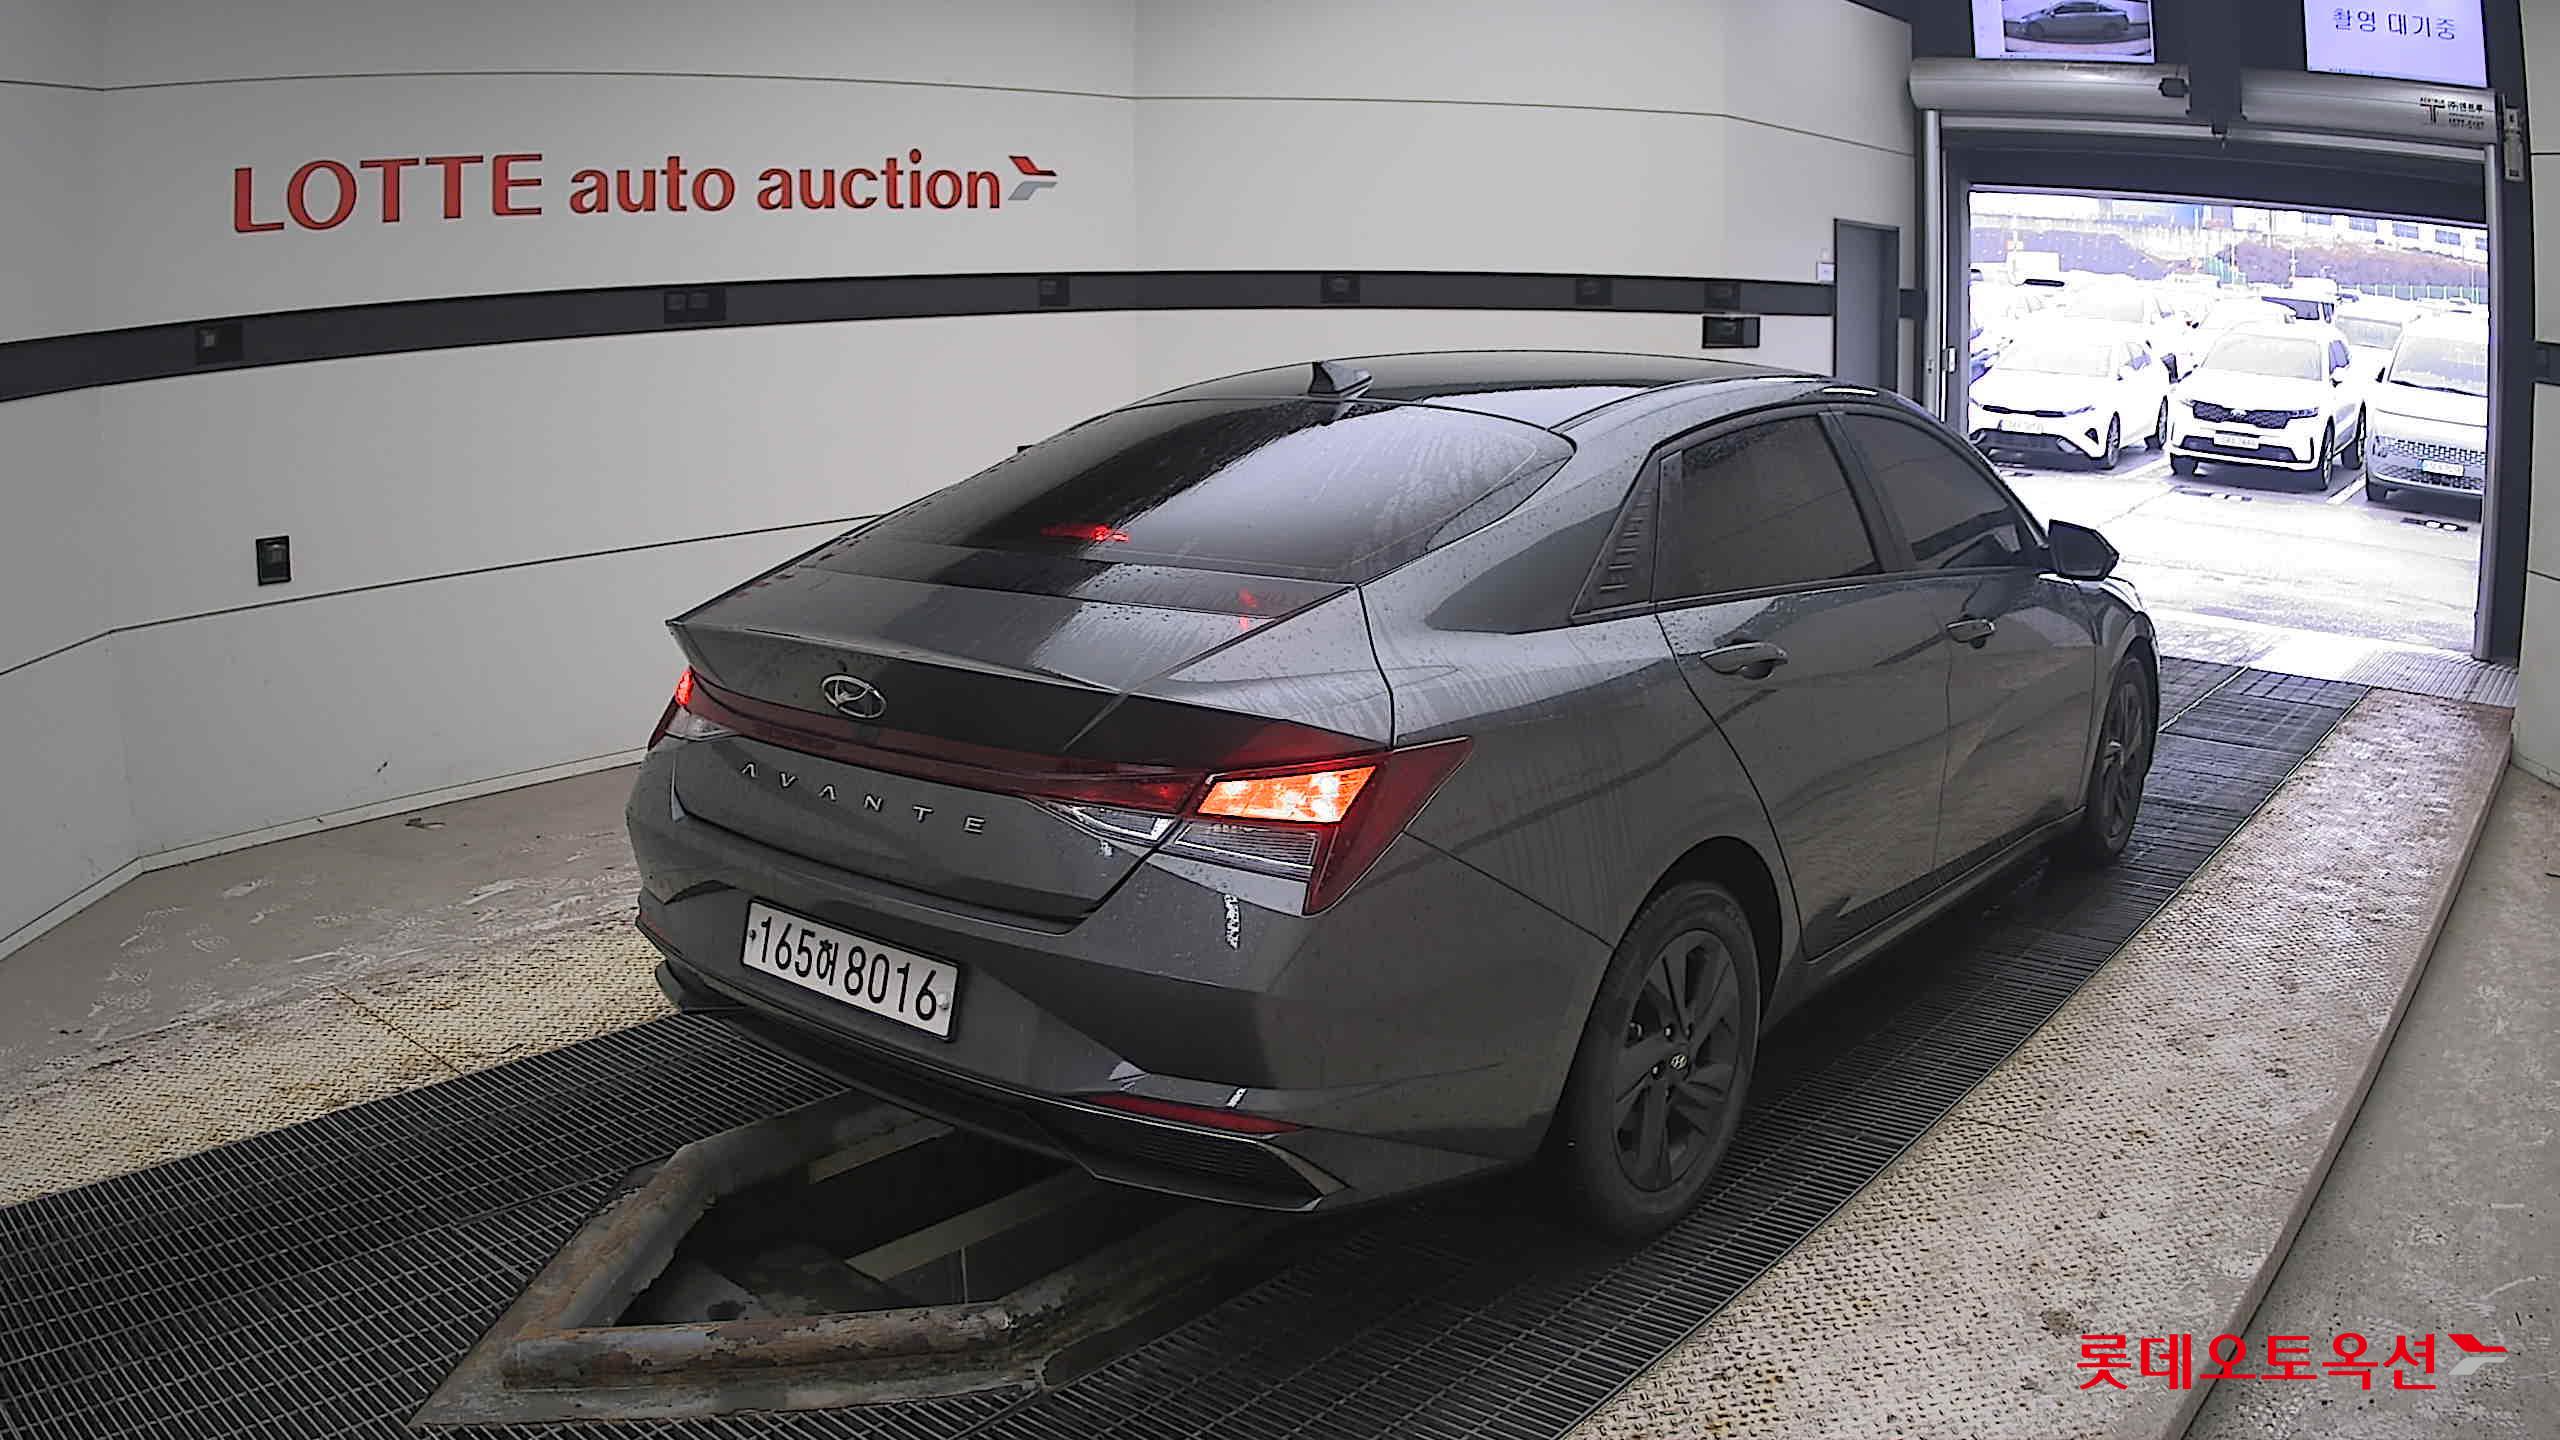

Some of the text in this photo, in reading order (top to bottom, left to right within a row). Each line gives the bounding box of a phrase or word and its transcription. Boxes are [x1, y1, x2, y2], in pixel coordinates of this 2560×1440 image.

[2334, 8, 2455, 40] 촬영 대기중
[234, 148, 1001, 234] LOTTE auto auction
[740, 761, 986, 835] AVANTE
